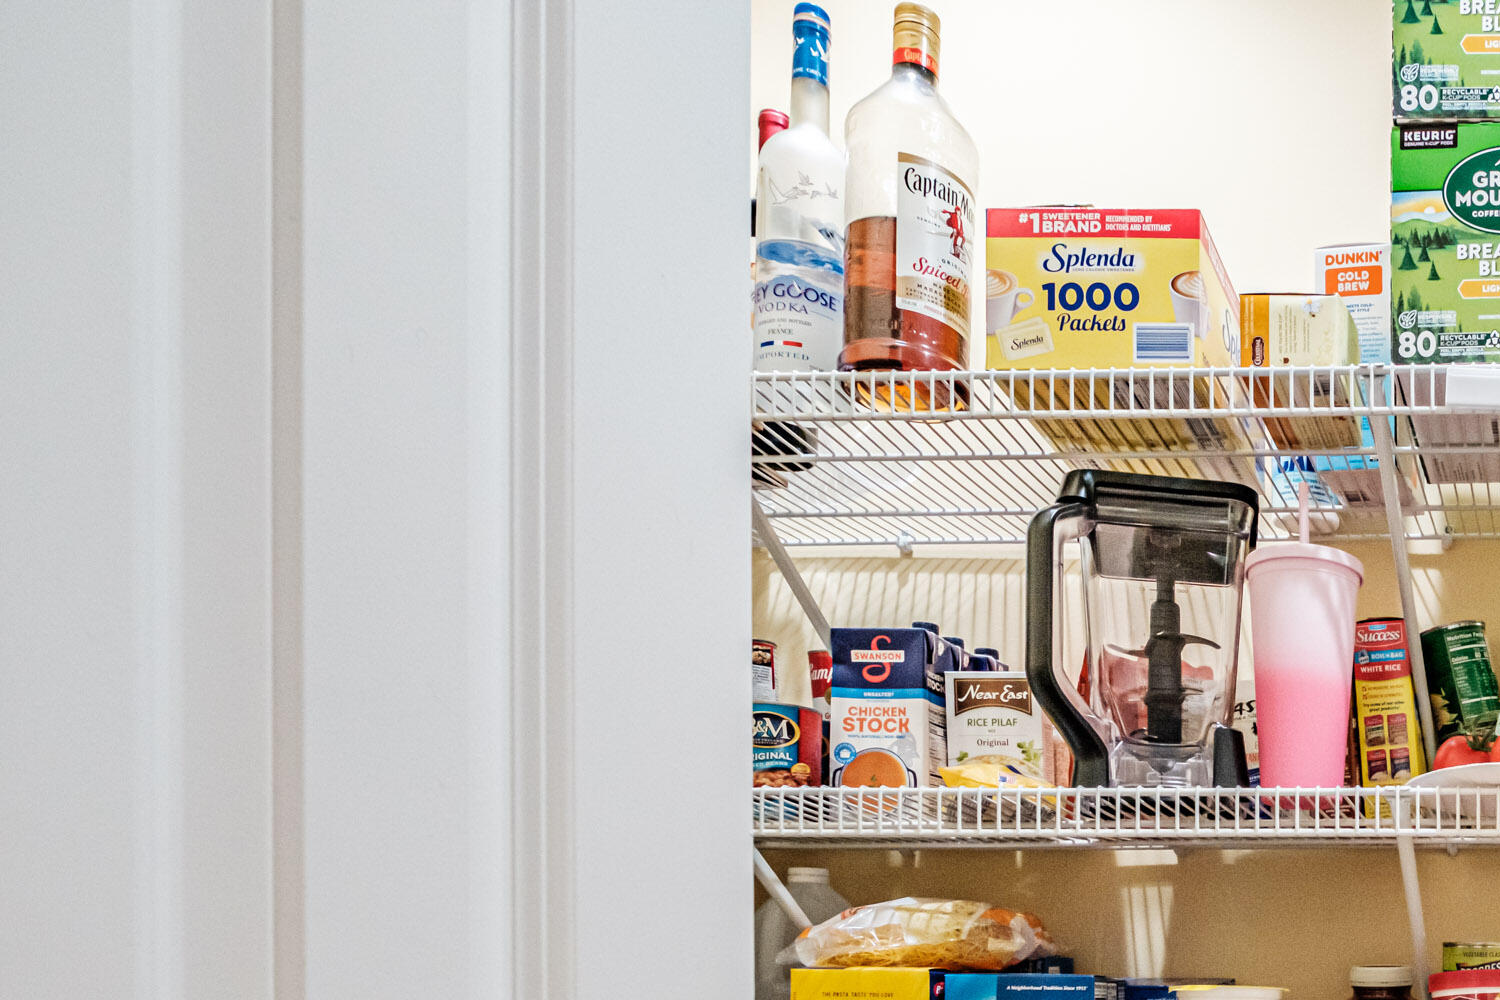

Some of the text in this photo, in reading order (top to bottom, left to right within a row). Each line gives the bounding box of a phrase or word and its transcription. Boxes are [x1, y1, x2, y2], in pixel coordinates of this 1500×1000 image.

[1400, 84, 1438, 111] 80
[1404, 130, 1456, 142] KEURIG
[1043, 221, 1101, 233] BRAND
[1042, 243, 1135, 273] Splenda
[912, 256, 960, 288] Spiced
[1337, 271, 1369, 282] COLD
[1337, 281, 1369, 292] BREW
[773, 283, 837, 312] GOOSE
[1042, 282, 1140, 312] 1000
[1057, 313, 1126, 331] Packets
[1011, 335, 1044, 351] Splenda
[1398, 330, 1437, 358] 80
[1356, 630, 1401, 642] Success
[853, 651, 902, 661] SWANSON
[1360, 664, 1401, 673] WHITE RICE
[957, 684, 1028, 702] Near East
[848, 706, 907, 718] CHICKEN
[842, 718, 910, 733] STOCK
[967, 717, 1018, 727] RICE PILAF
[977, 737, 1009, 748] Original
